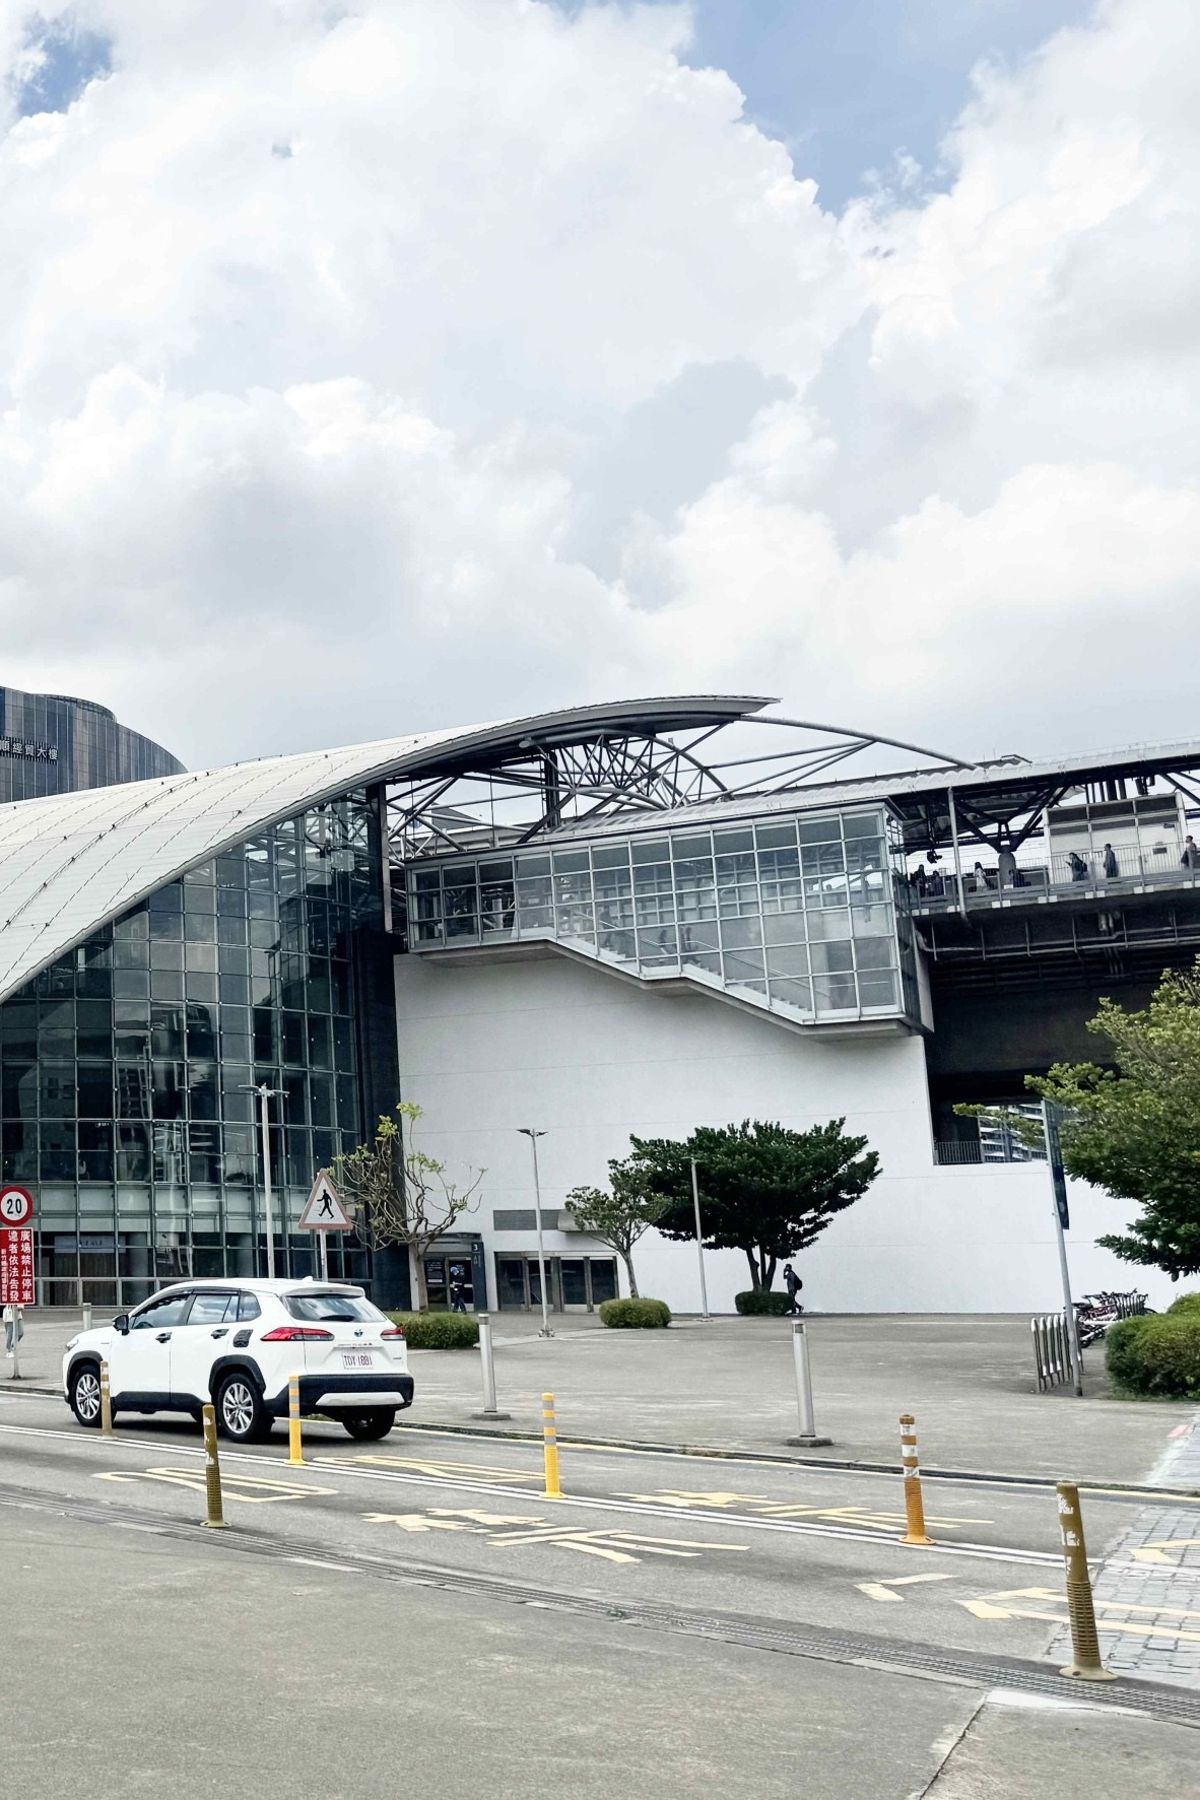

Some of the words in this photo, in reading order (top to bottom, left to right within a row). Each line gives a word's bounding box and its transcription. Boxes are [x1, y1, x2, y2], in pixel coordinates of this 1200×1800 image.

[7, 1199, 22, 1215] 20
[8, 1230, 19, 1302] 違者依法告發
[20, 1230, 32, 1301] 廣場禁止停車
